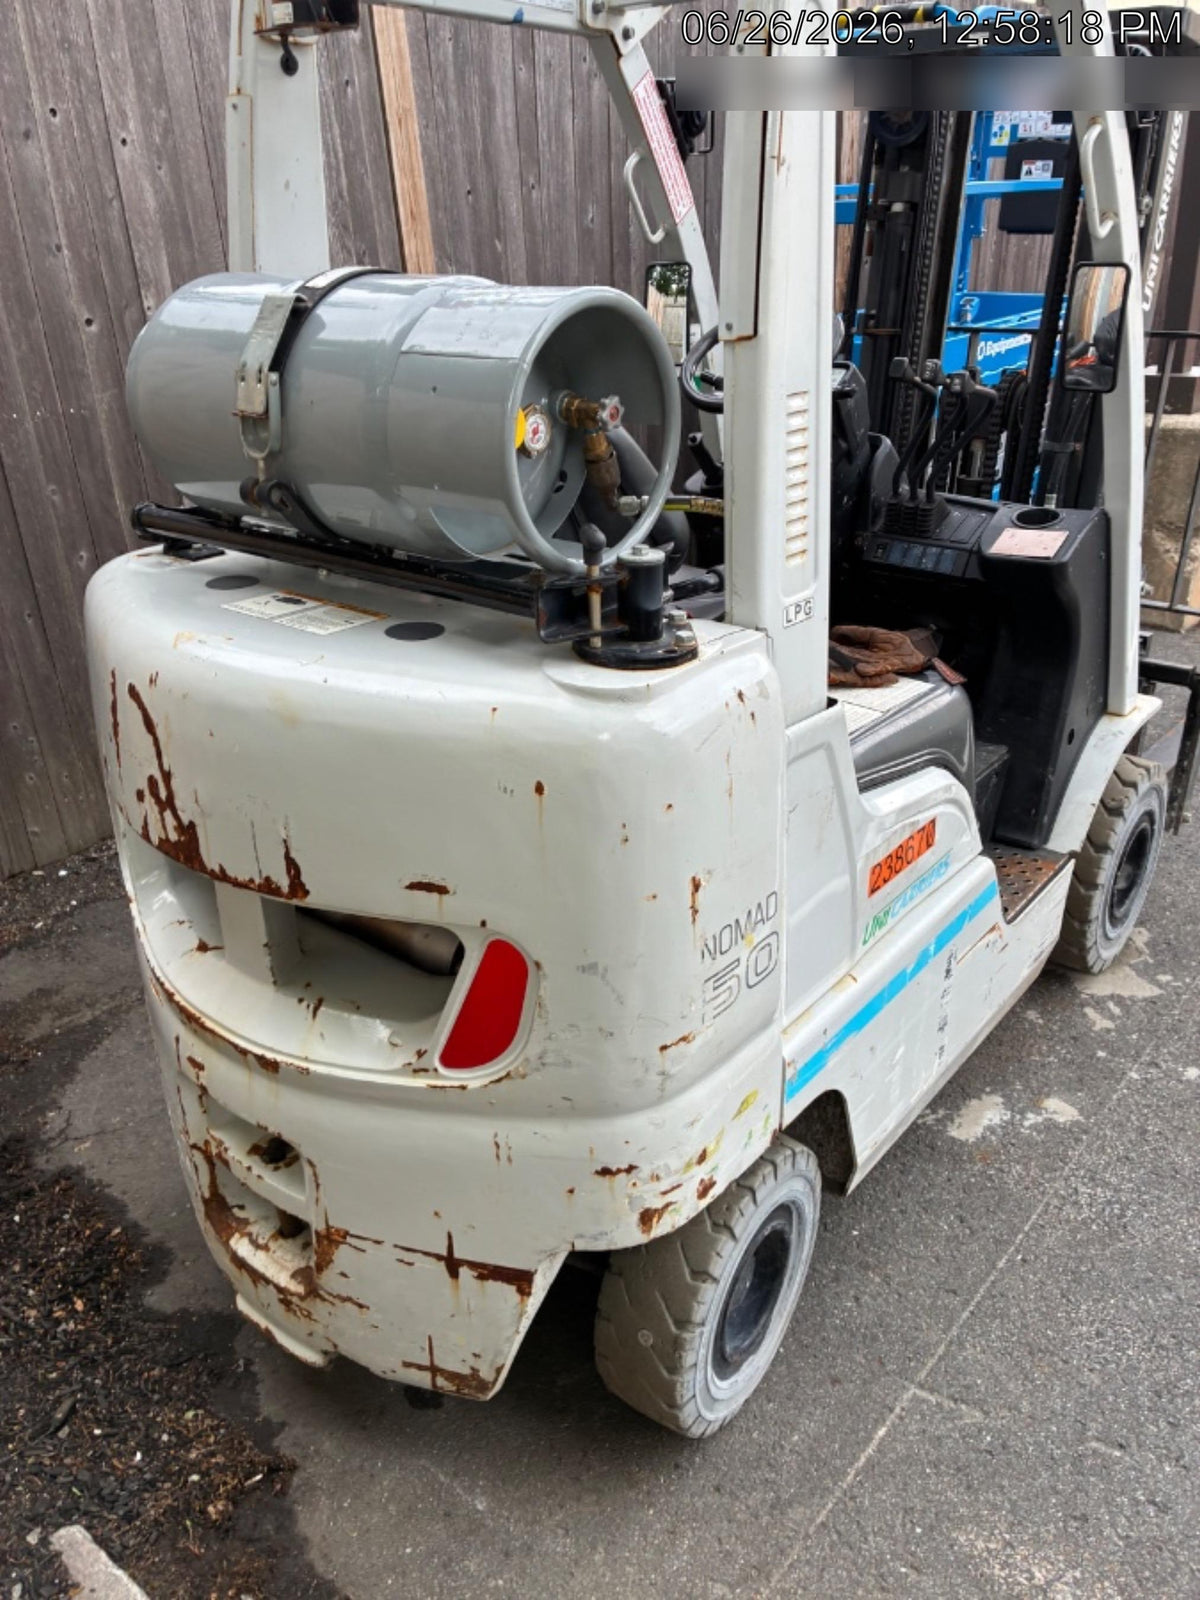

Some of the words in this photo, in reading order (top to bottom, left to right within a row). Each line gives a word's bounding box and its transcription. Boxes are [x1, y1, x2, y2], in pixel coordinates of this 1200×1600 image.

[785, 600, 812, 625] LPG
[868, 816, 937, 897] 238670
[701, 890, 778, 963] NOMAD
[701, 930, 780, 1025] 50
